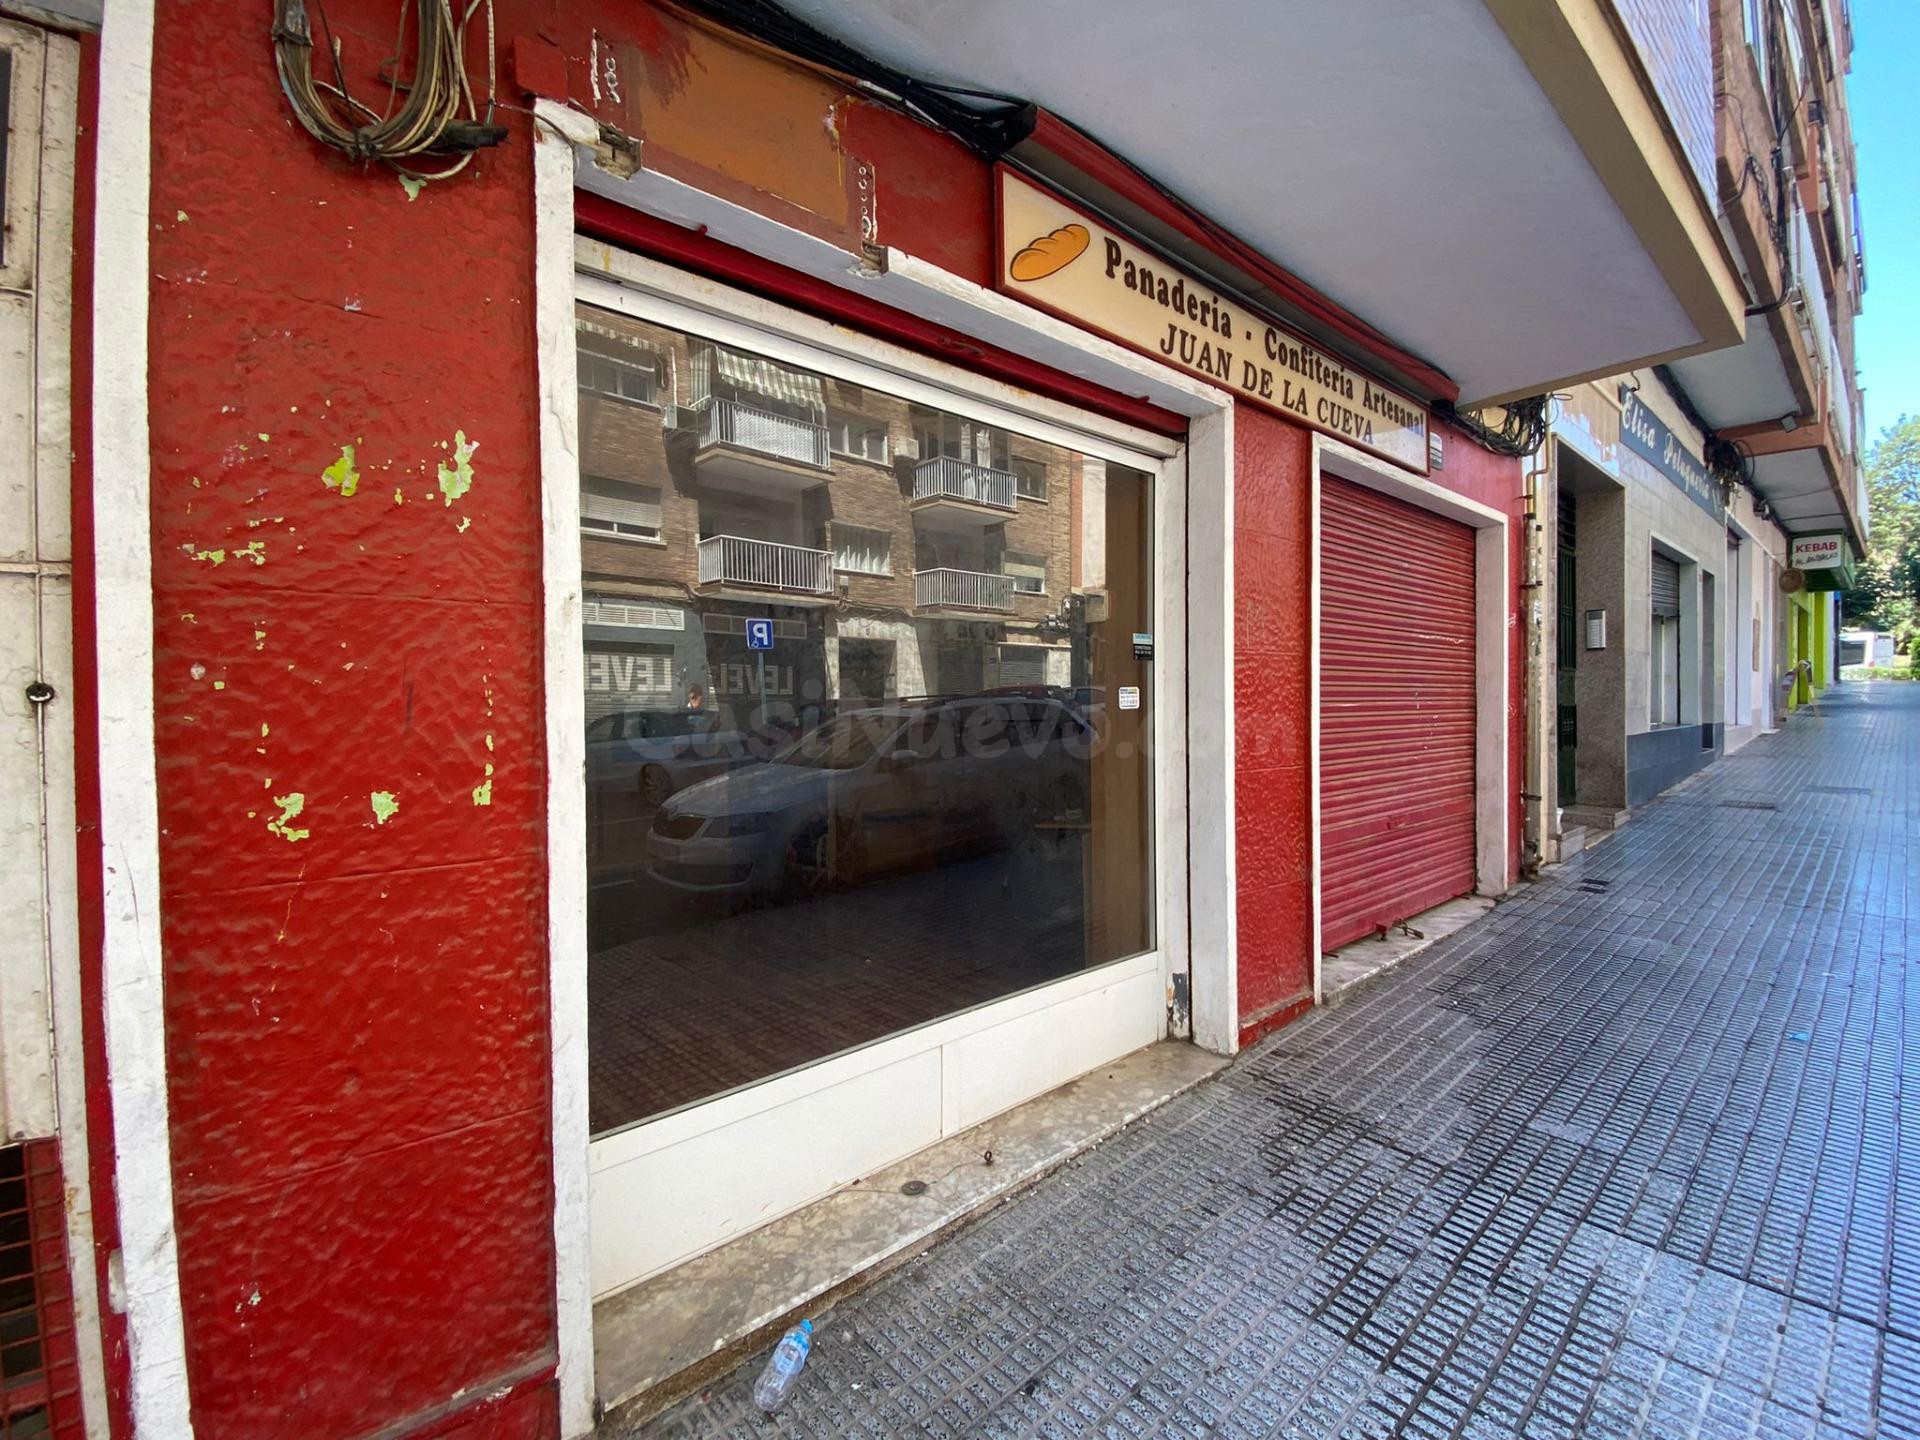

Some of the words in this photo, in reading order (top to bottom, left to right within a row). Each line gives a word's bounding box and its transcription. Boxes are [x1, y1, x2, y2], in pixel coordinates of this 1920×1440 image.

[1104, 236, 1232, 339] Panaderia
[1362, 381, 1424, 438] Artesanal
[1160, 323, 1233, 381] JUAN
[1242, 360, 1273, 400] DE
[1282, 379, 1309, 416] LA
[1317, 397, 1374, 445] CUEVA
[1621, 390, 1656, 449] Elisa
[1795, 541, 1838, 553] KEBAB
